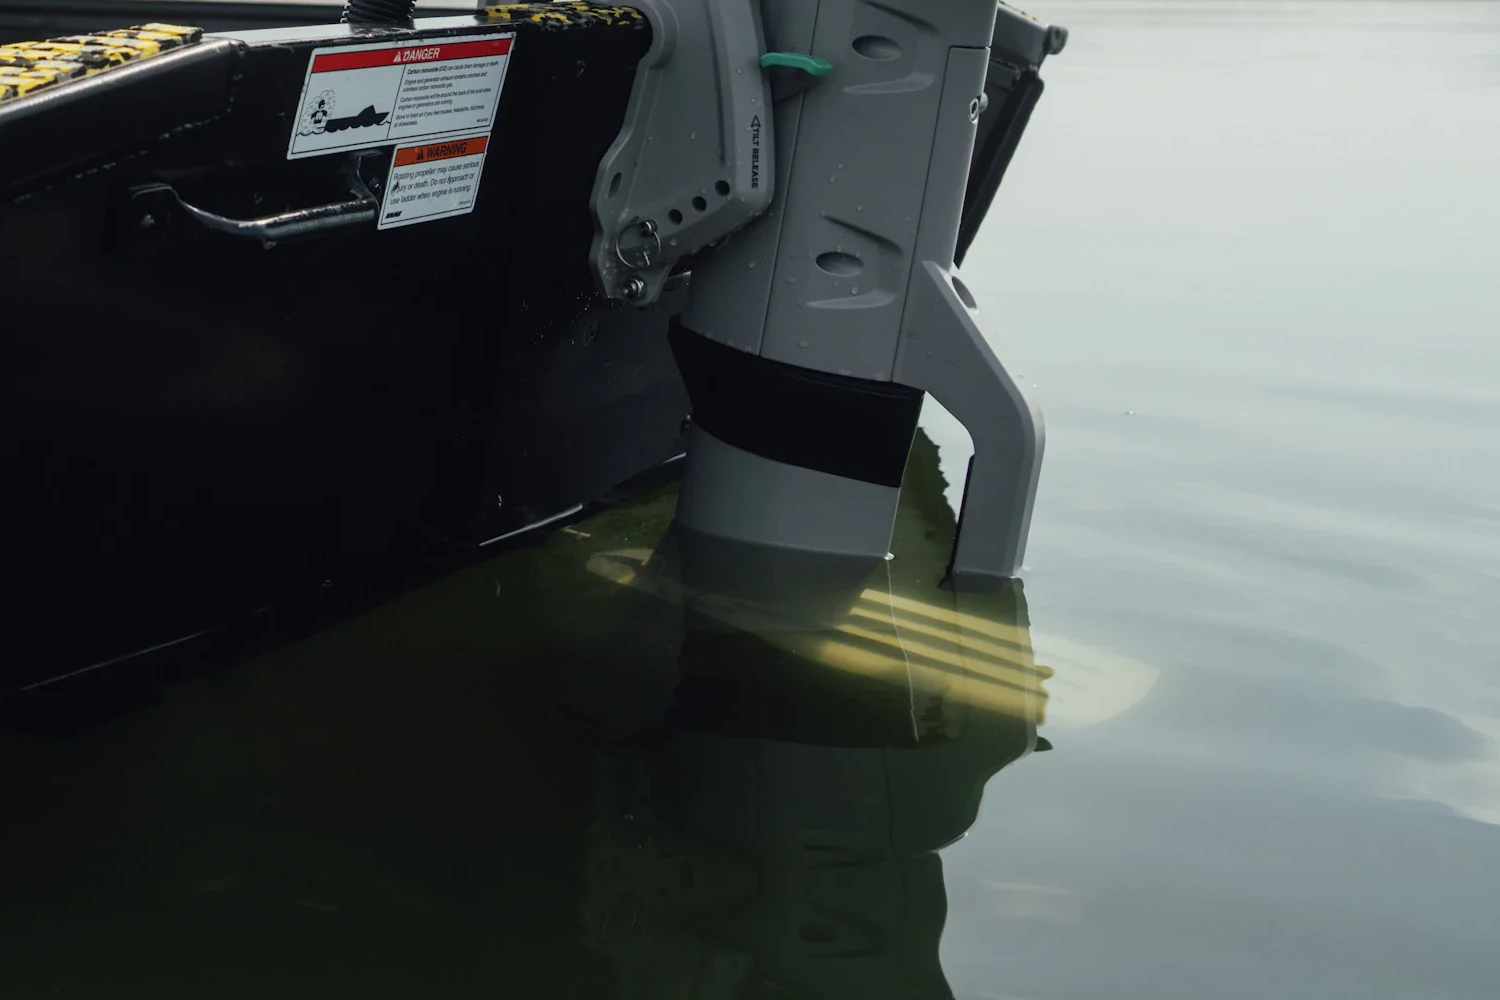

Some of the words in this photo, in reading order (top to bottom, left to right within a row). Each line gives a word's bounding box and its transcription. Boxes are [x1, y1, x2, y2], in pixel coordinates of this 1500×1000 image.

[402, 48, 440, 61] DANGER
[752, 127, 760, 146] TILT
[426, 142, 467, 159] WARNING
[393, 172, 414, 180] Rotating
[414, 168, 436, 179] propeller
[437, 166, 447, 174] may
[448, 164, 462, 172] cause
[463, 161, 479, 170] serious
[751, 148, 759, 189] RELEASE
[430, 178, 438, 186] Do
[469, 172, 475, 180] or
[390, 197, 400, 205] use
[401, 193, 417, 202] ladder
[417, 192, 430, 200] when
[432, 189, 447, 198] engine
